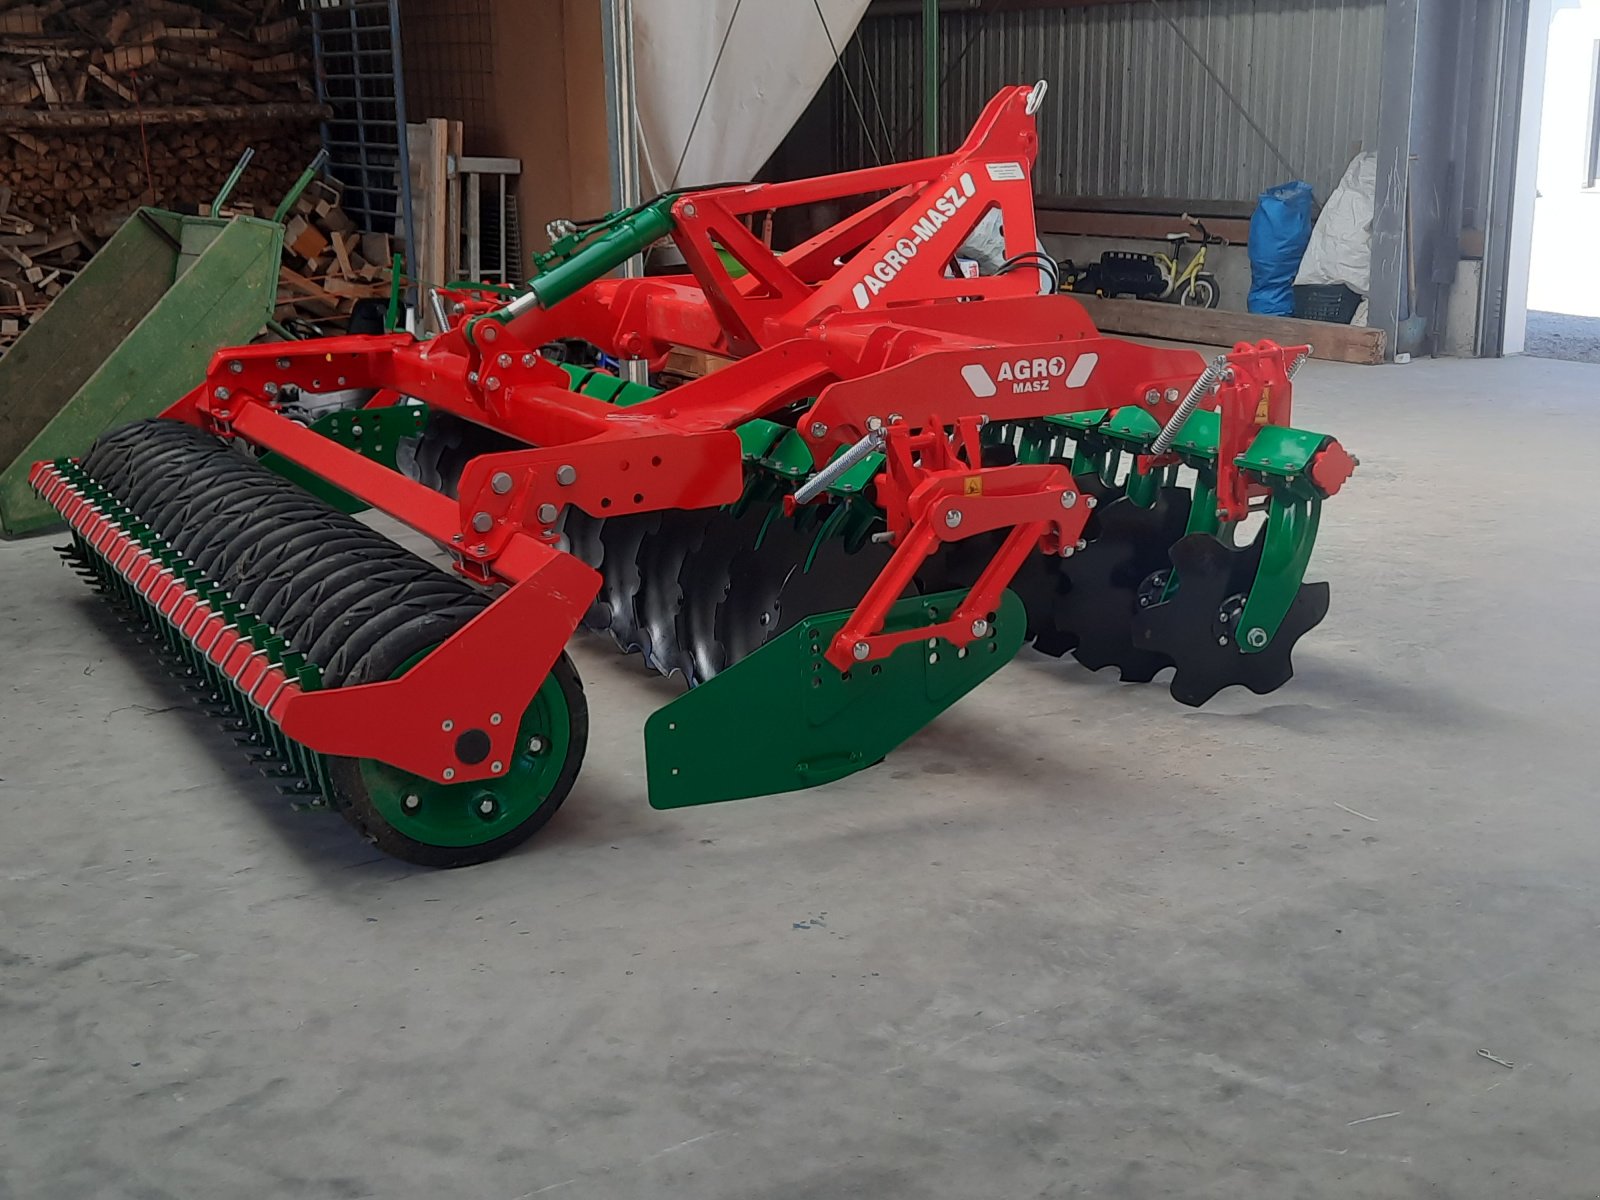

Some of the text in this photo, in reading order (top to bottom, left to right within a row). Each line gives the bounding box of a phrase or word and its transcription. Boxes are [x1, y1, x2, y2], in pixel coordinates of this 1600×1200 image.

[863, 186, 968, 296] AGRO-MASZ
[997, 356, 1066, 382] AGRO
[1012, 380, 1050, 394] MASZ
